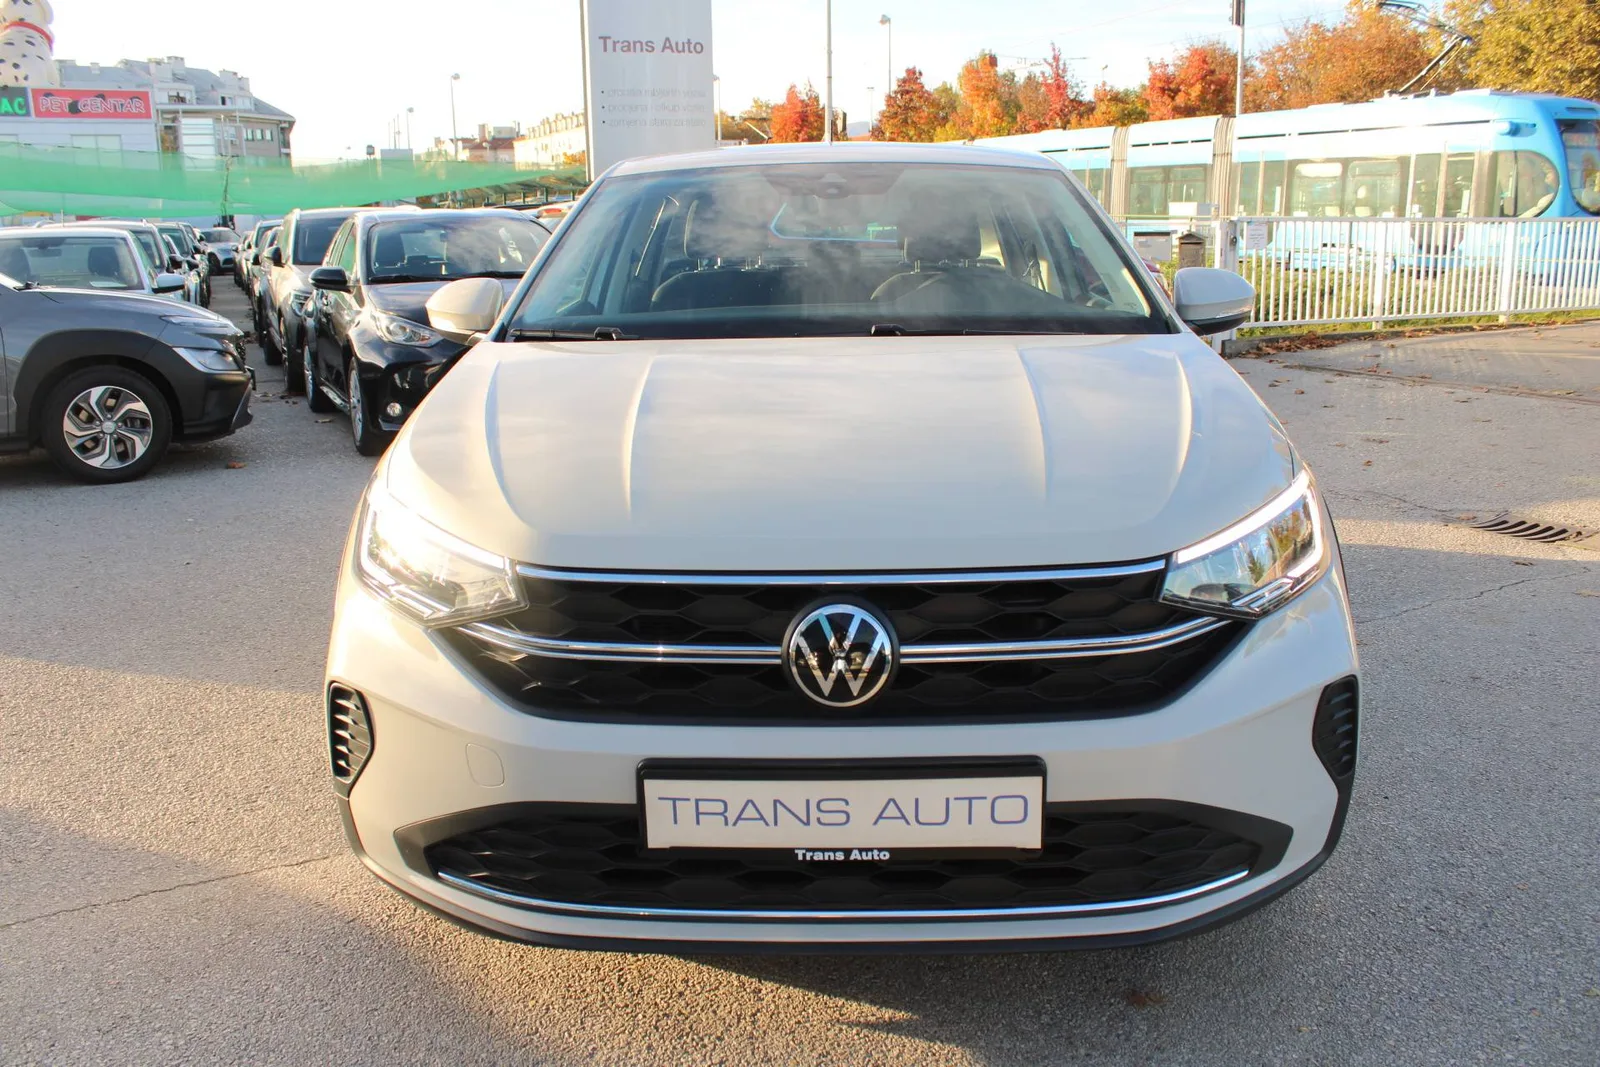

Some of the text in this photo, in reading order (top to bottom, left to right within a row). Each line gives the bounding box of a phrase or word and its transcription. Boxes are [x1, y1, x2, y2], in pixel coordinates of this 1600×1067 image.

[598, 36, 705, 55] Trans Auto
[39, 96, 146, 114] PET CENTAR
[657, 794, 1029, 828] TRANS AUTO
[794, 848, 891, 862] Trans Auto
